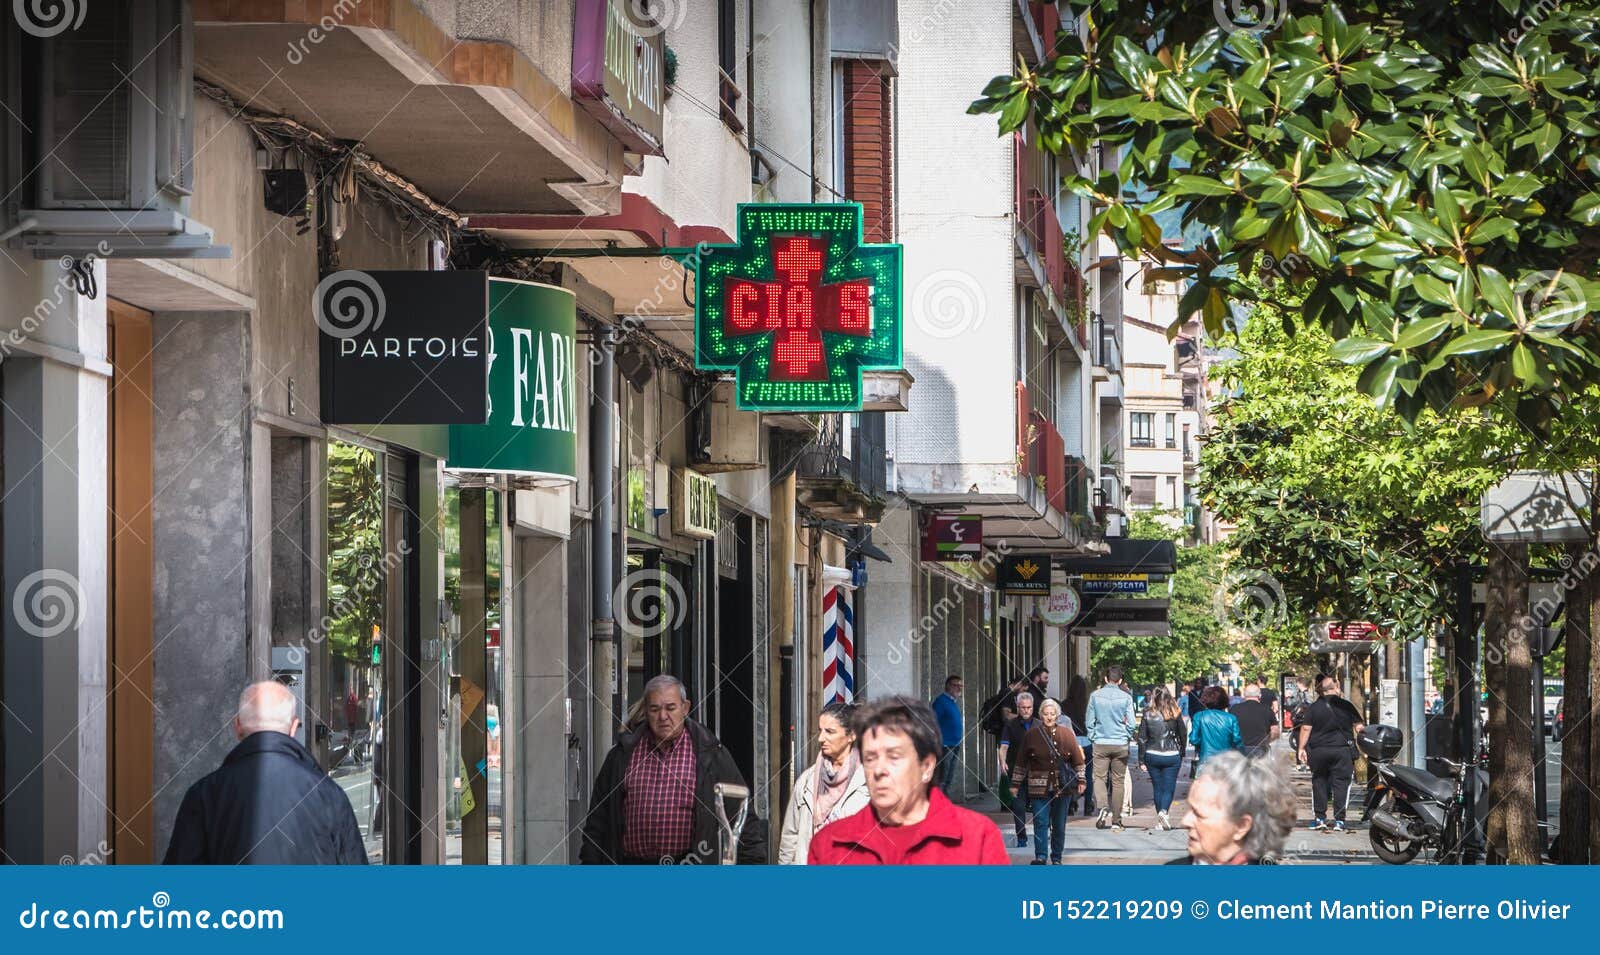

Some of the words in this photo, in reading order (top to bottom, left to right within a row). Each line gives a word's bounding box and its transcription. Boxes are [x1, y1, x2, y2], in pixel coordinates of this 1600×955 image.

[746, 212, 853, 230] FARMACIA
[733, 284, 812, 328] CIA
[840, 285, 866, 328] S
[340, 337, 479, 358] PARFOIS
[745, 383, 852, 401] FARMACIA
